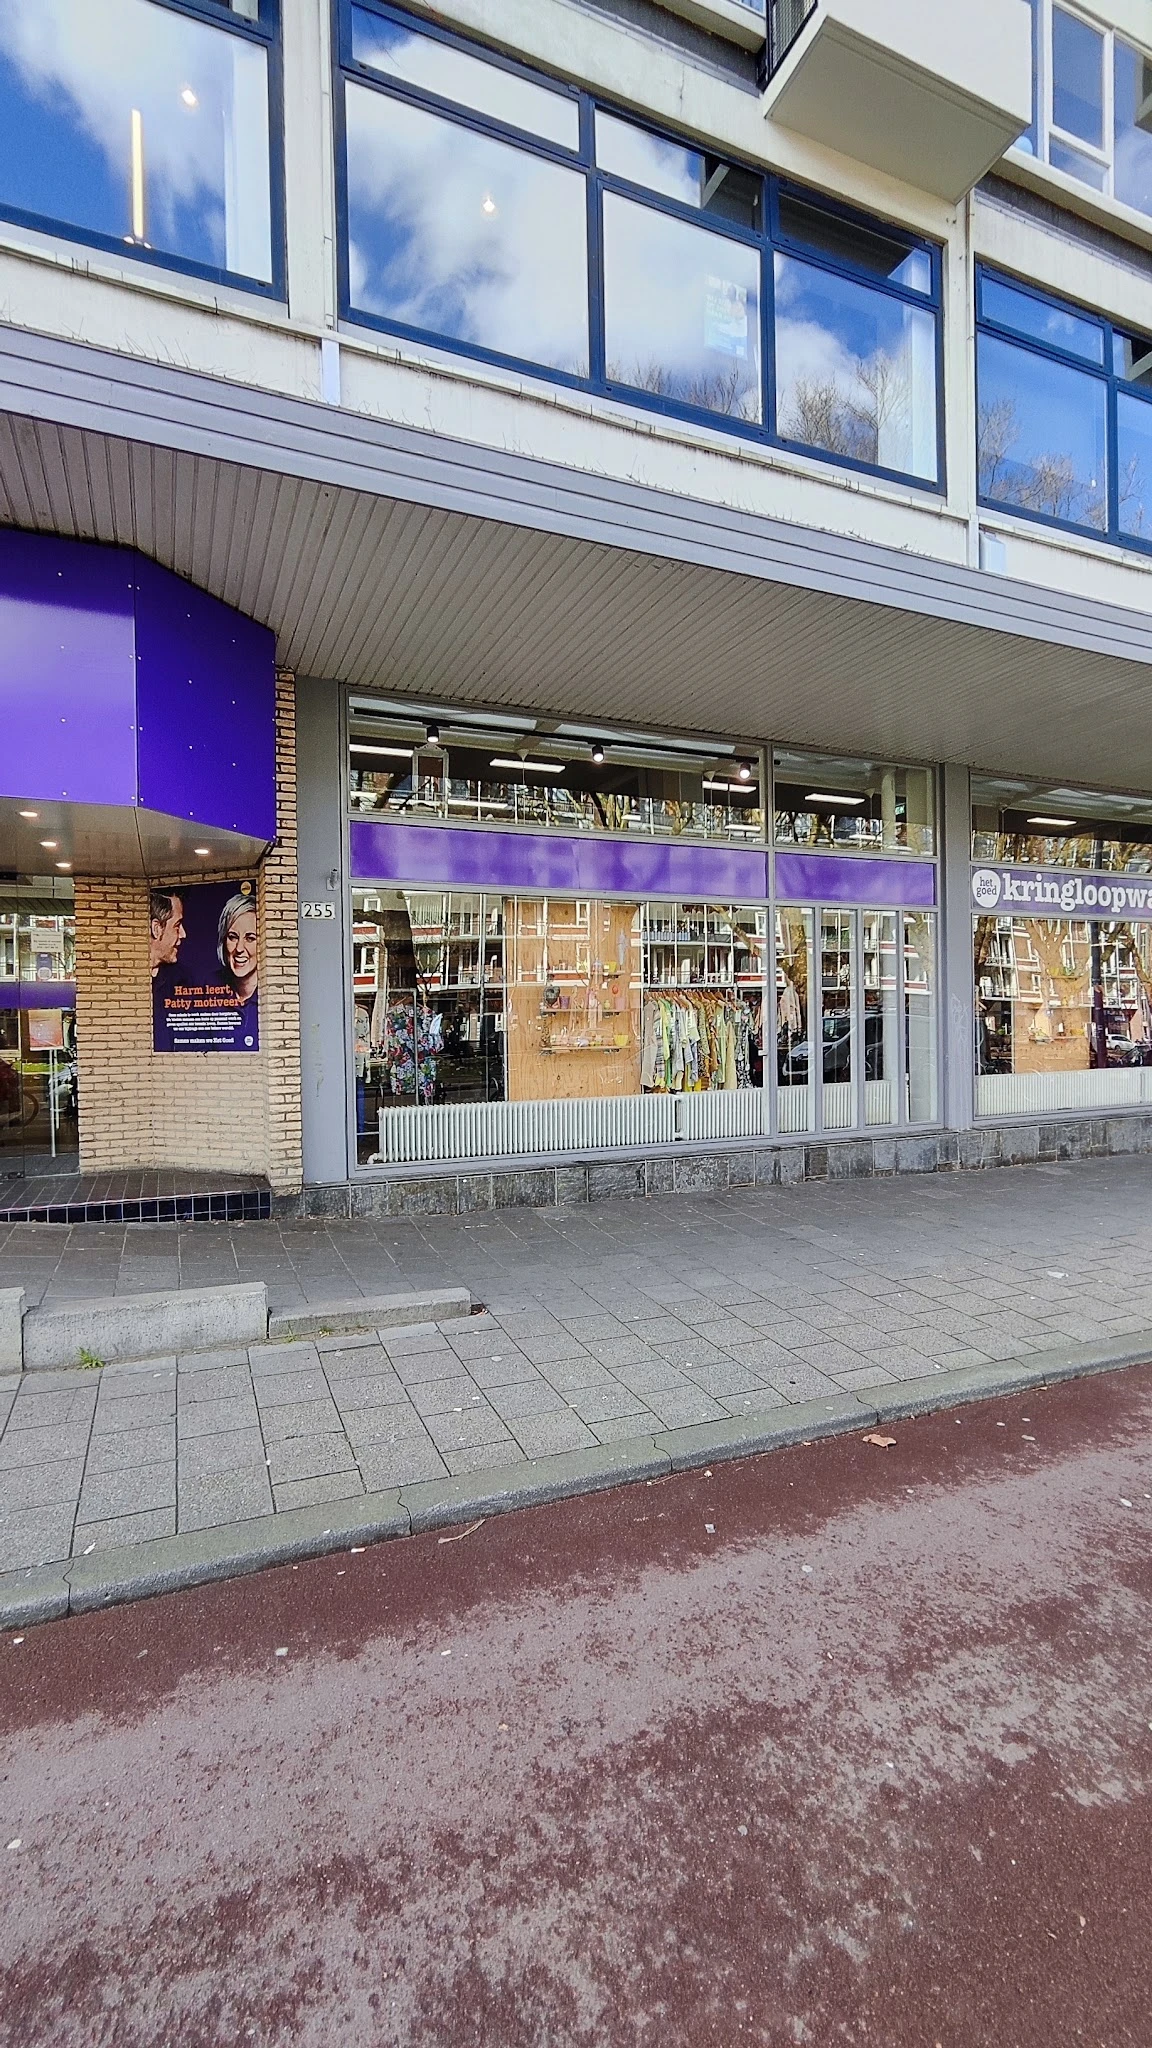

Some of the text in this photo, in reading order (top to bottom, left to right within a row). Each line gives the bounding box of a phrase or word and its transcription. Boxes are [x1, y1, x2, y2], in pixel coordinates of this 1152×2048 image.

[979, 876, 993, 887] het
[976, 885, 997, 898] goed
[303, 903, 333, 918] 255
[174, 984, 234, 996] Harm leert,
[164, 996, 245, 1010] Patty motiveert
